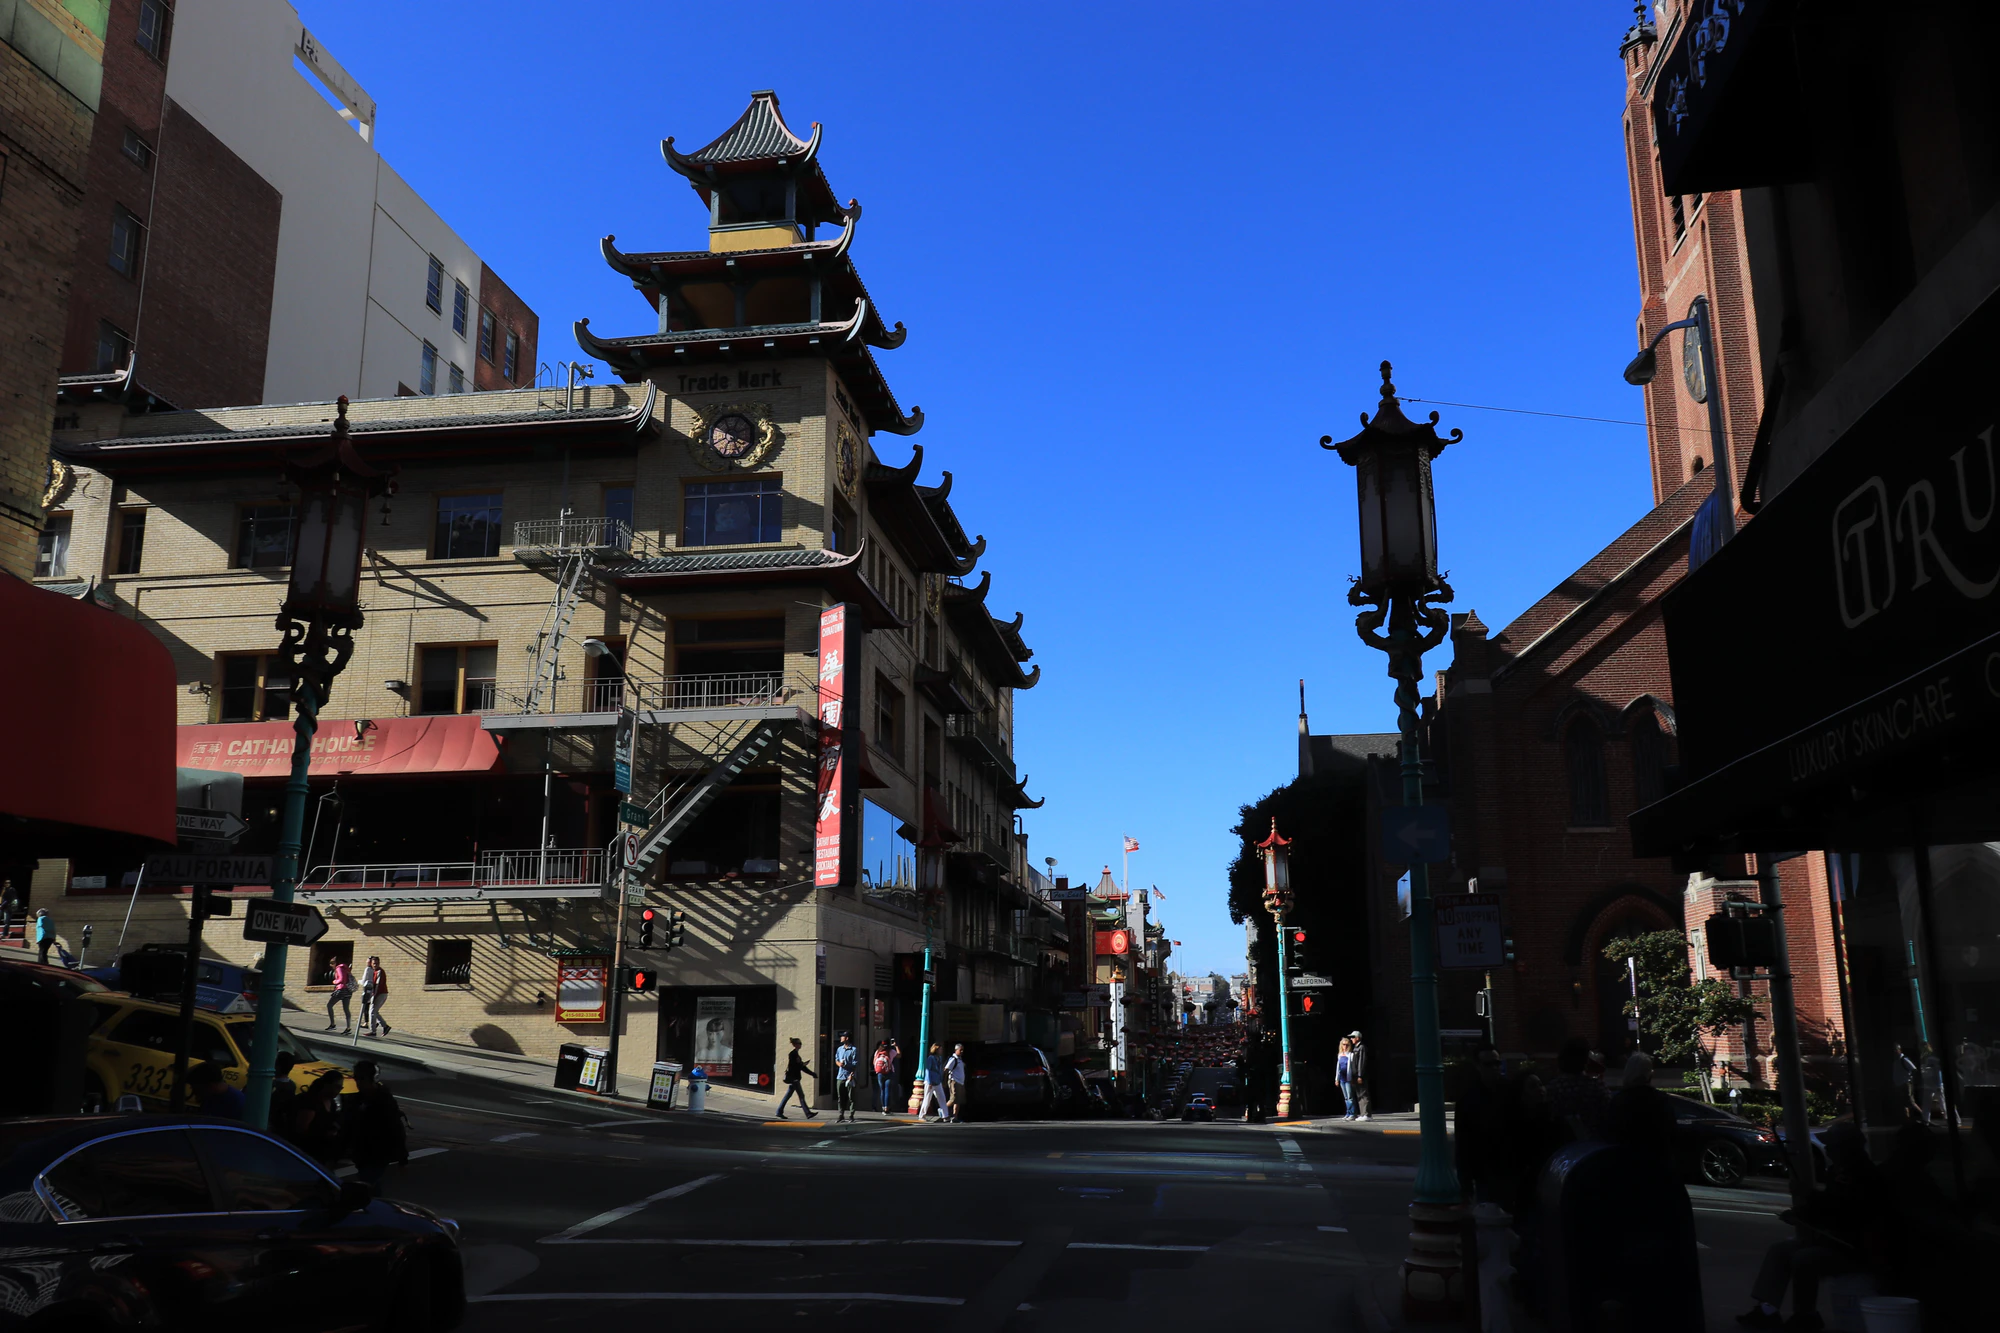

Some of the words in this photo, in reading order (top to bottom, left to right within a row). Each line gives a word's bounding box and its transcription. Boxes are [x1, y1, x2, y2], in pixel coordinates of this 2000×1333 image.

[678, 372, 729, 392] Trade
[738, 368, 782, 388] Mark
[1788, 724, 1847, 782] LUXURY
[1852, 676, 1957, 757] SKINCARE
[314, 735, 377, 753] HOUSE
[222, 757, 292, 768] RESTAURAN
[310, 755, 371, 765] COCKTAILS
[200, 817, 225, 830] WAY
[626, 808, 645, 824] Grant
[149, 859, 267, 879] CALIFORNIA
[628, 885, 645, 896] GRANT
[255, 912, 279, 930] ONE
[283, 916, 307, 933] WAY
[1437, 908, 1453, 924] NO
[1455, 911, 1498, 923] STOPPING
[1458, 927, 1481, 940] ANY
[1457, 942, 1486, 955] TIME
[1292, 978, 1331, 986] CALIFORNIA
